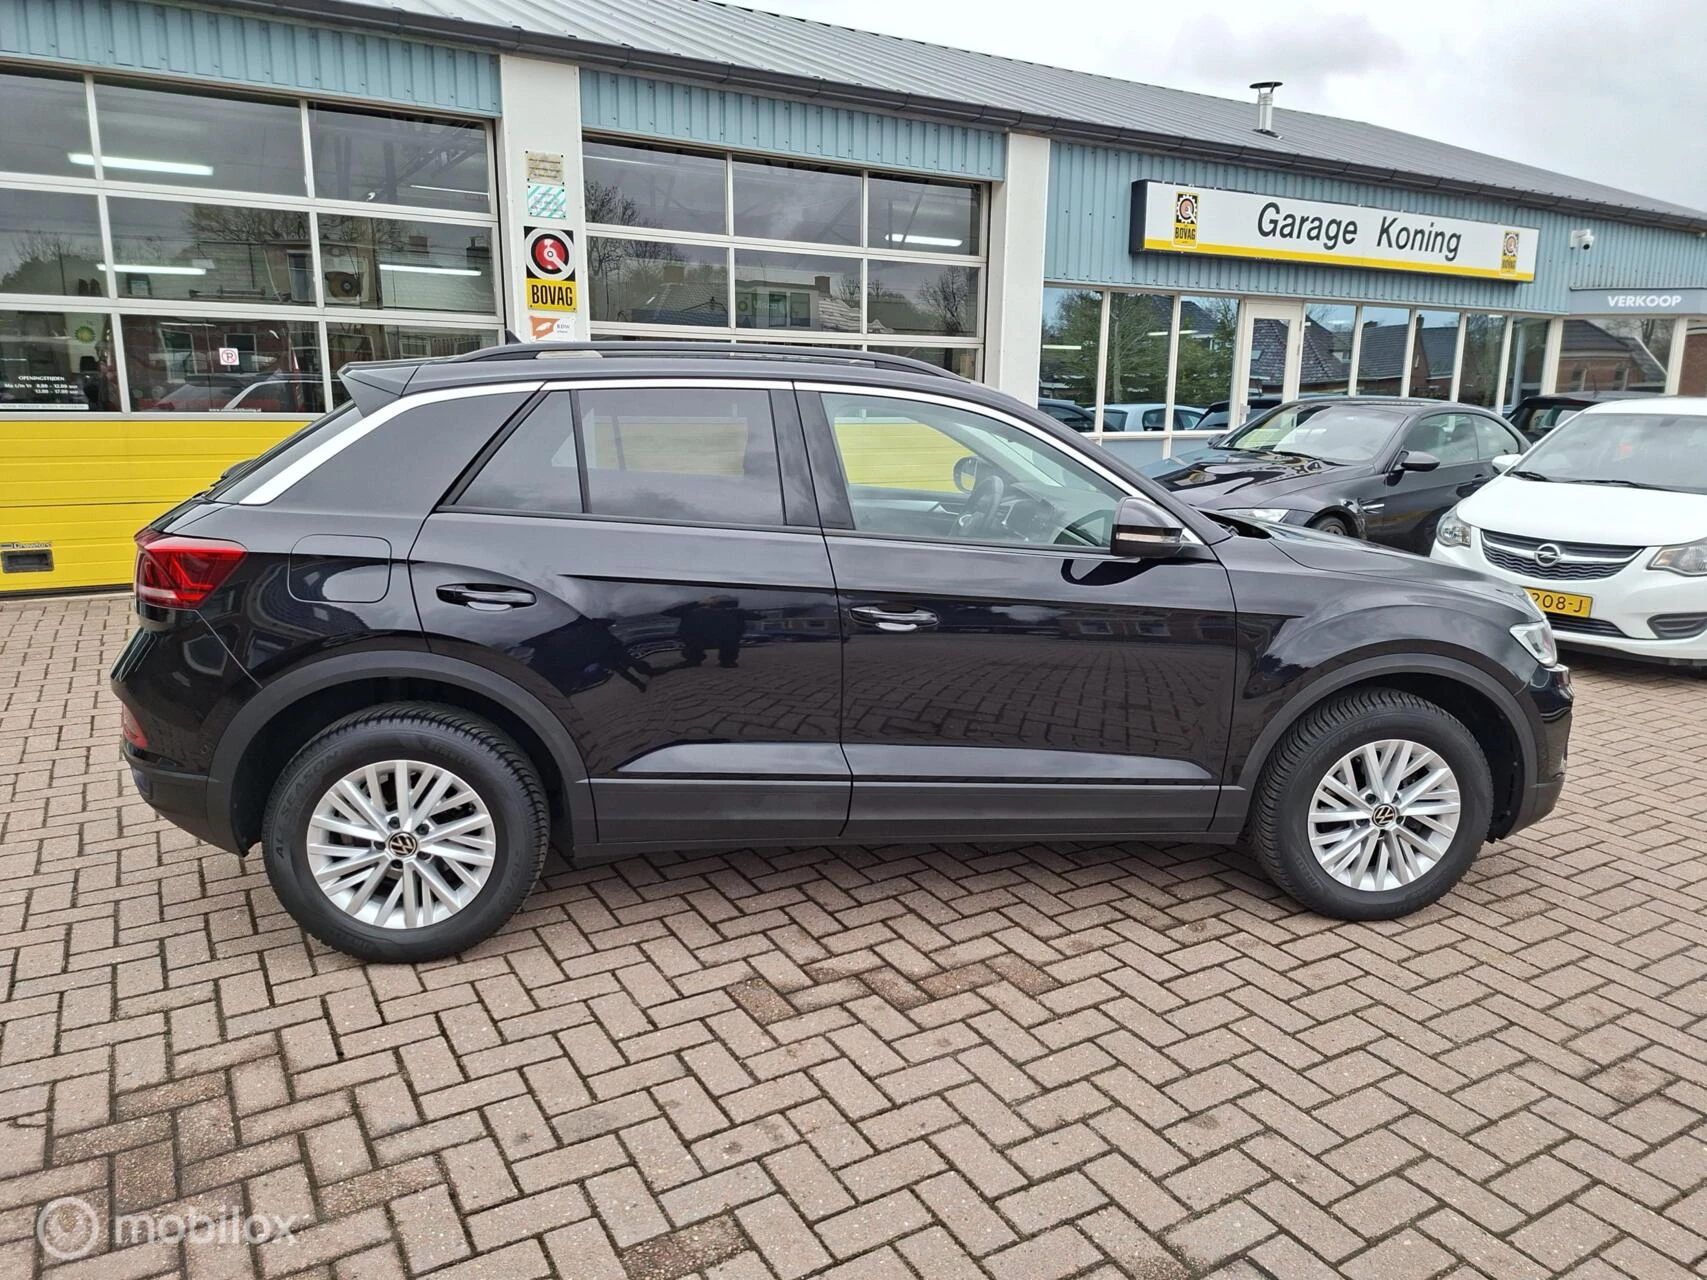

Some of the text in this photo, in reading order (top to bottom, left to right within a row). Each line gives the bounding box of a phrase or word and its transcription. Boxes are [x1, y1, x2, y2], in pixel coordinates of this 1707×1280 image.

[1174, 226, 1197, 241] BOVAG
[1257, 202, 1462, 262] Garage Koning
[531, 284, 573, 307] BOVAG
[1607, 295, 1682, 307] VERKOOP
